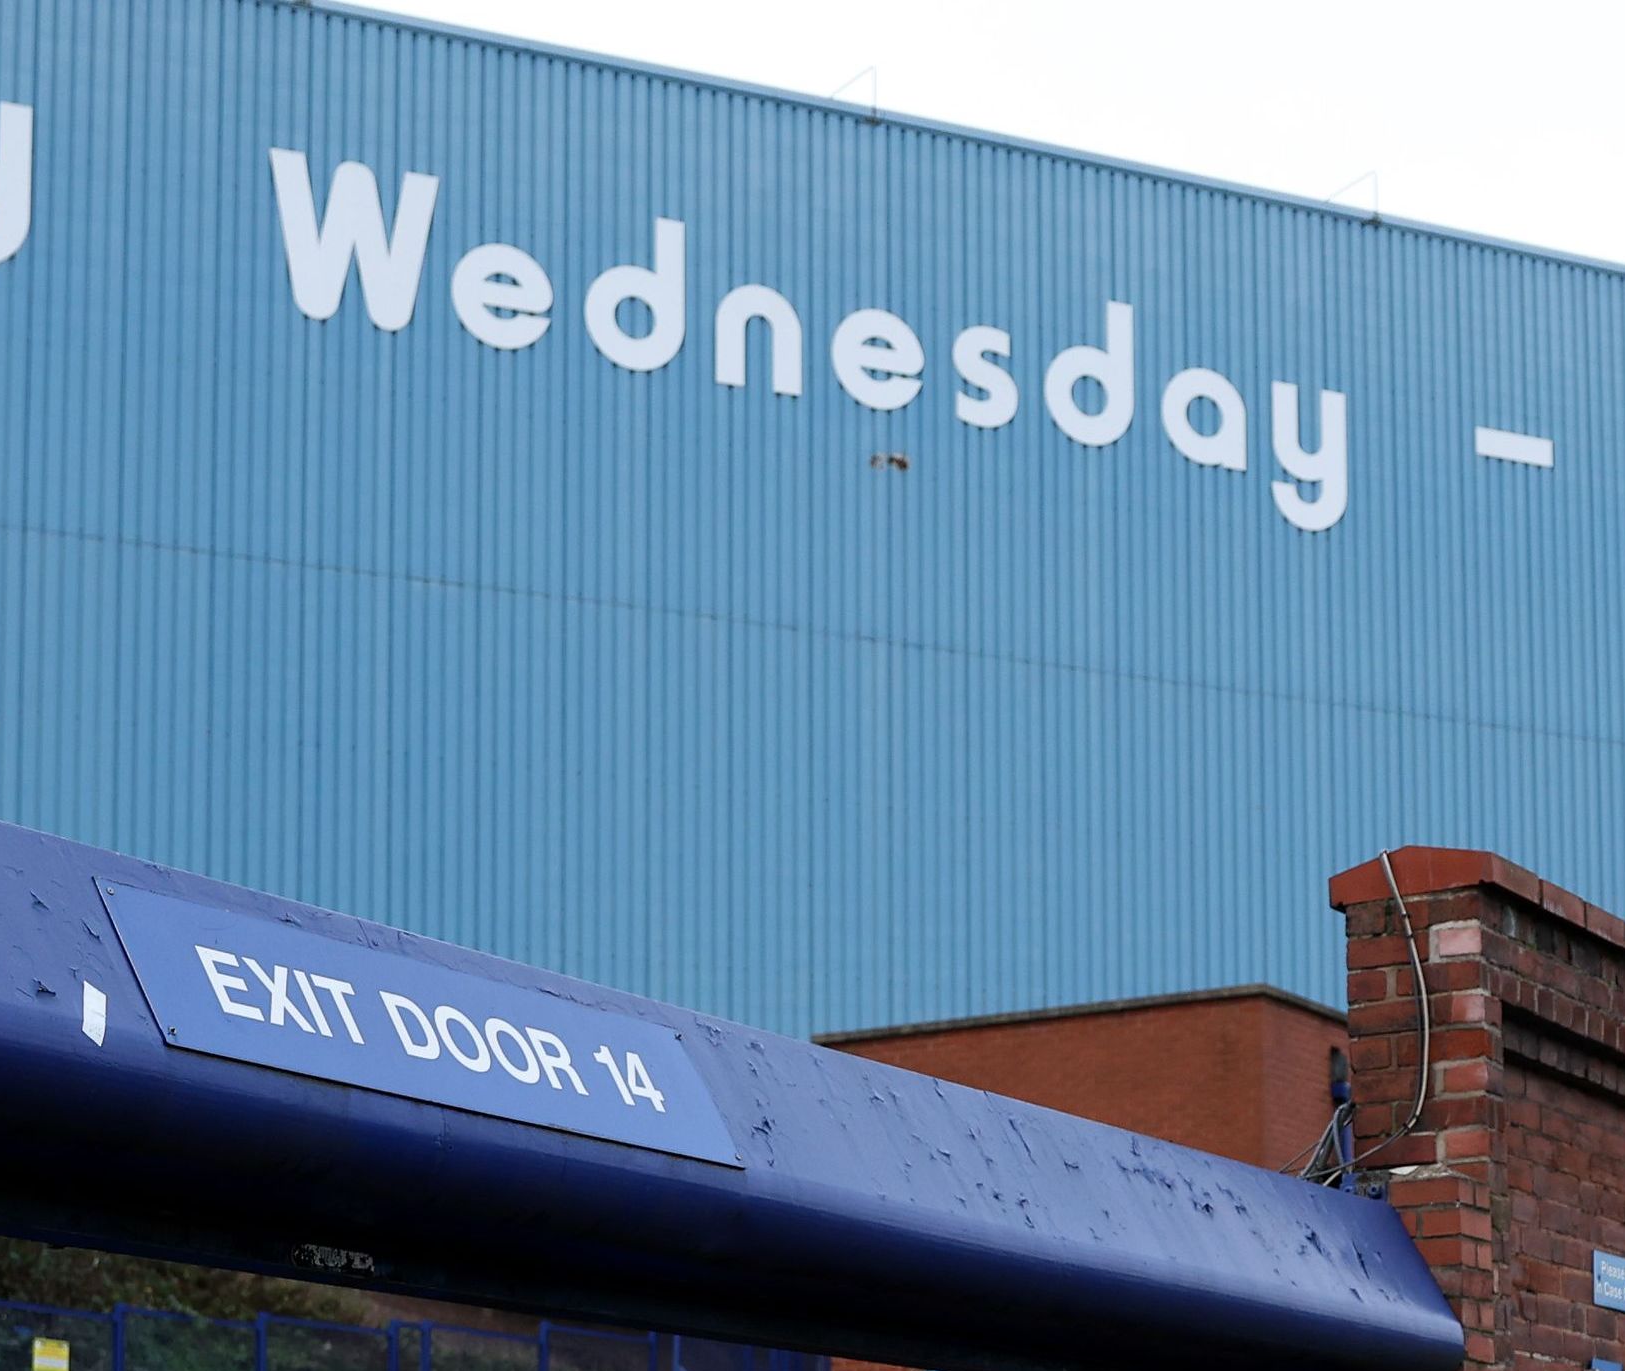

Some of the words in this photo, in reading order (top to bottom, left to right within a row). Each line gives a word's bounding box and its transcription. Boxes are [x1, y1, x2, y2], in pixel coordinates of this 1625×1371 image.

[269, 147, 1347, 532] Wednesday
[194, 945, 365, 1045] EXIT
[379, 990, 590, 1096] DOOR
[594, 1044, 666, 1113] 14
[1600, 1260, 1625, 1281] Please
